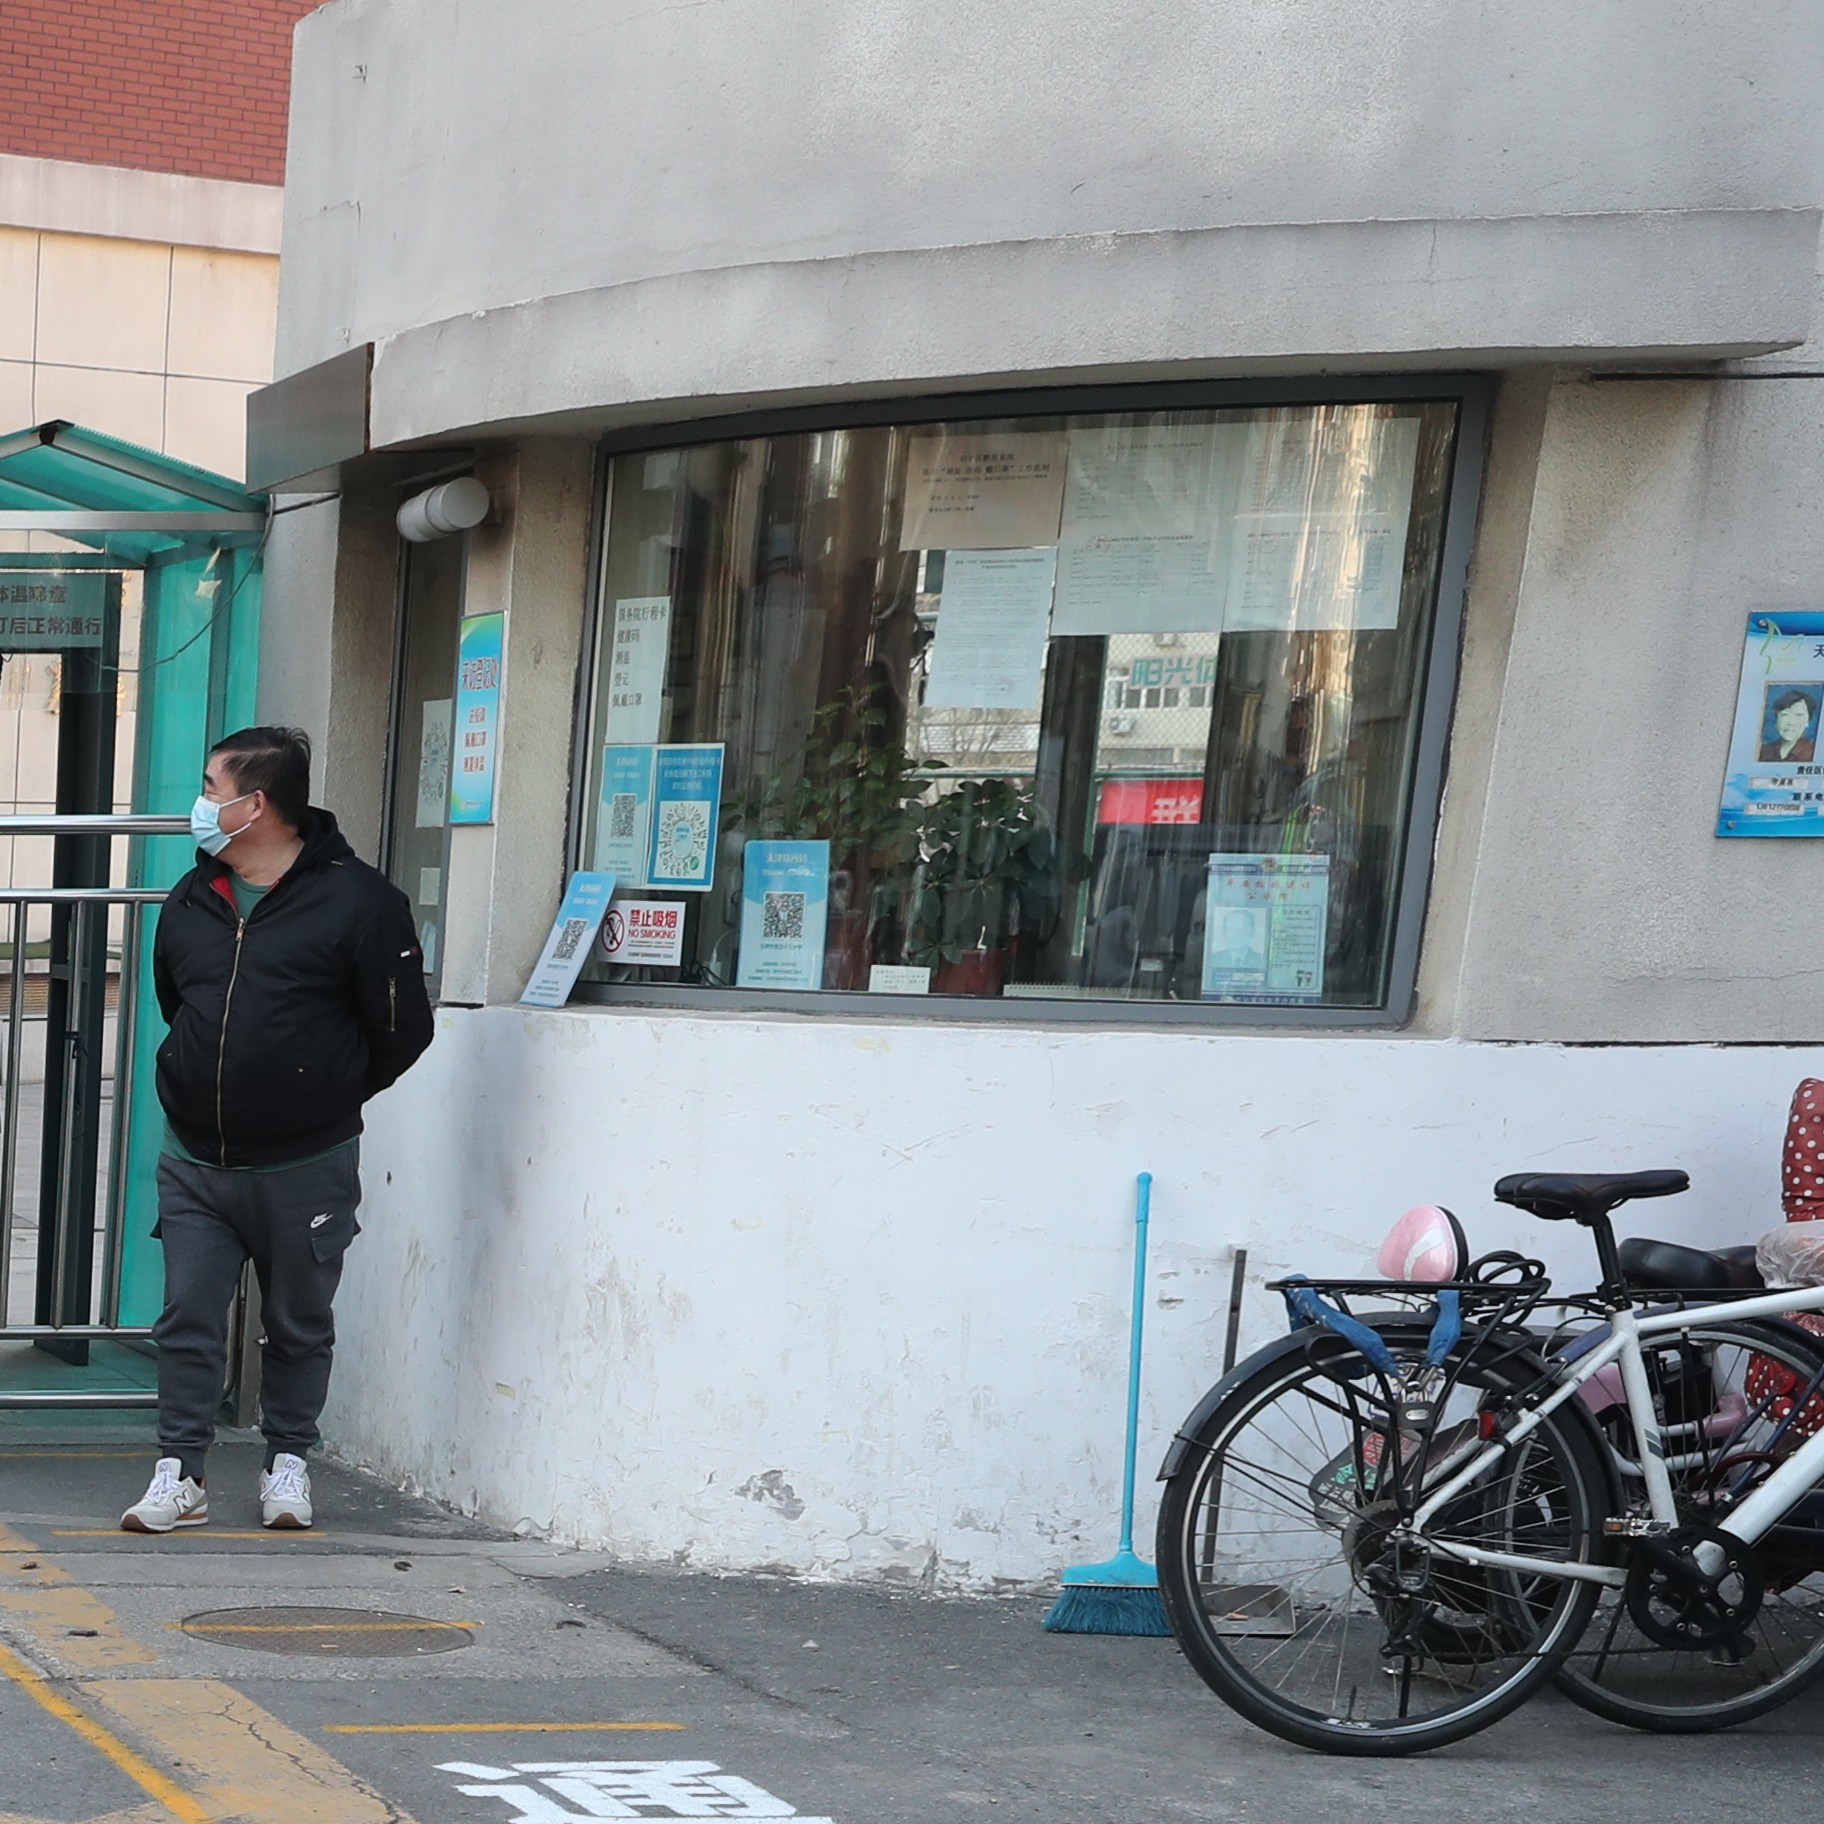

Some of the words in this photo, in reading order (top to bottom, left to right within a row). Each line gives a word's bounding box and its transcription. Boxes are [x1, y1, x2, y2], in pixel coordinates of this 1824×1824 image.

[629, 909, 677, 928] 禁止吸烟
[627, 928, 640, 938] NO
[640, 929, 676, 940] SMOKING
